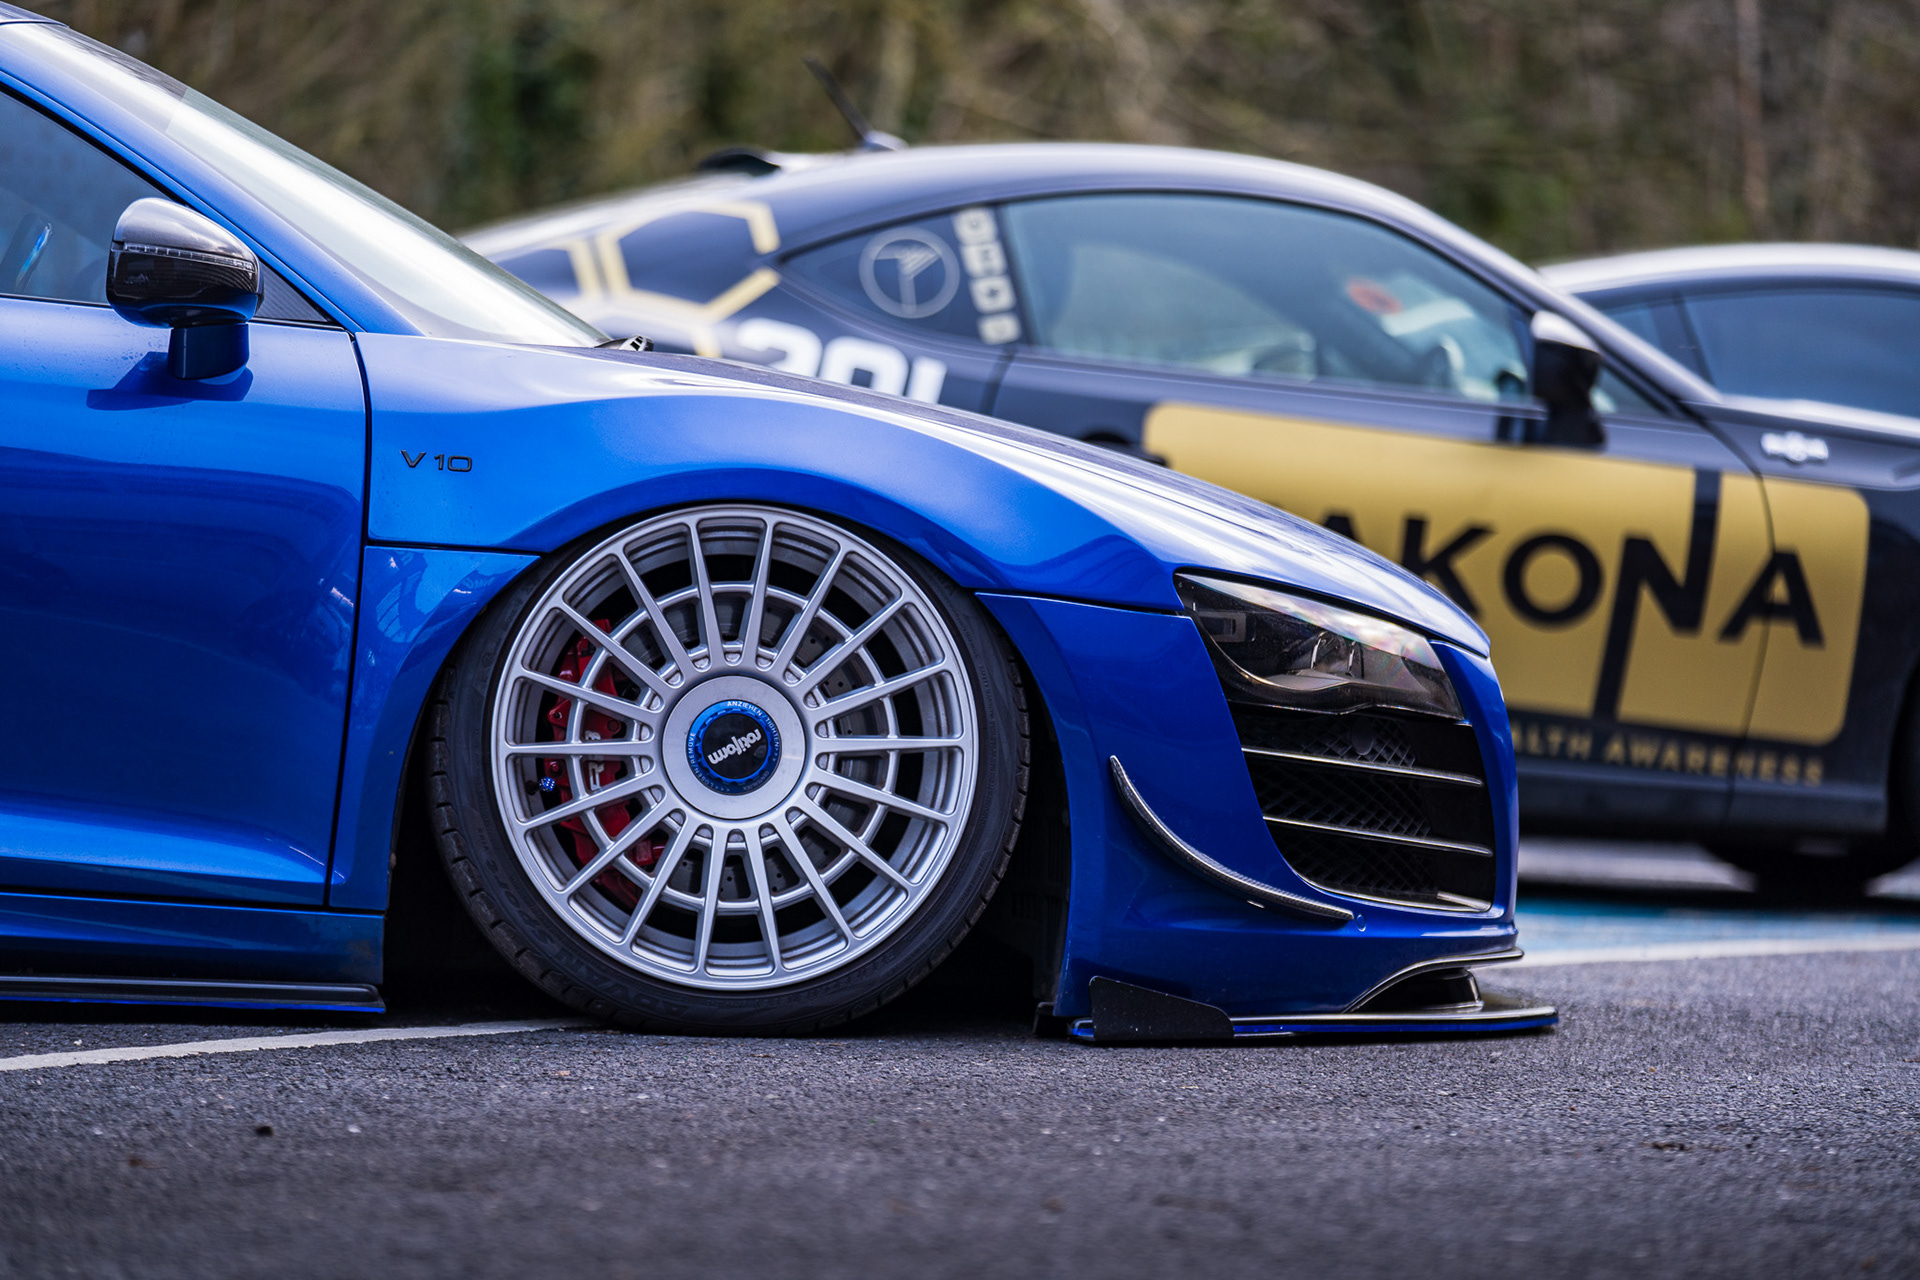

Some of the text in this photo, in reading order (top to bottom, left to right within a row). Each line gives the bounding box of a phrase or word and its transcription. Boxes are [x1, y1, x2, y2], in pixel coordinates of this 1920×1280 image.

[707, 728, 762, 765] rotiform
[727, 701, 763, 717] ANZIEHEN
[765, 716, 780, 748] TIGHTEN
[1603, 733, 1826, 789] AWARENESS
